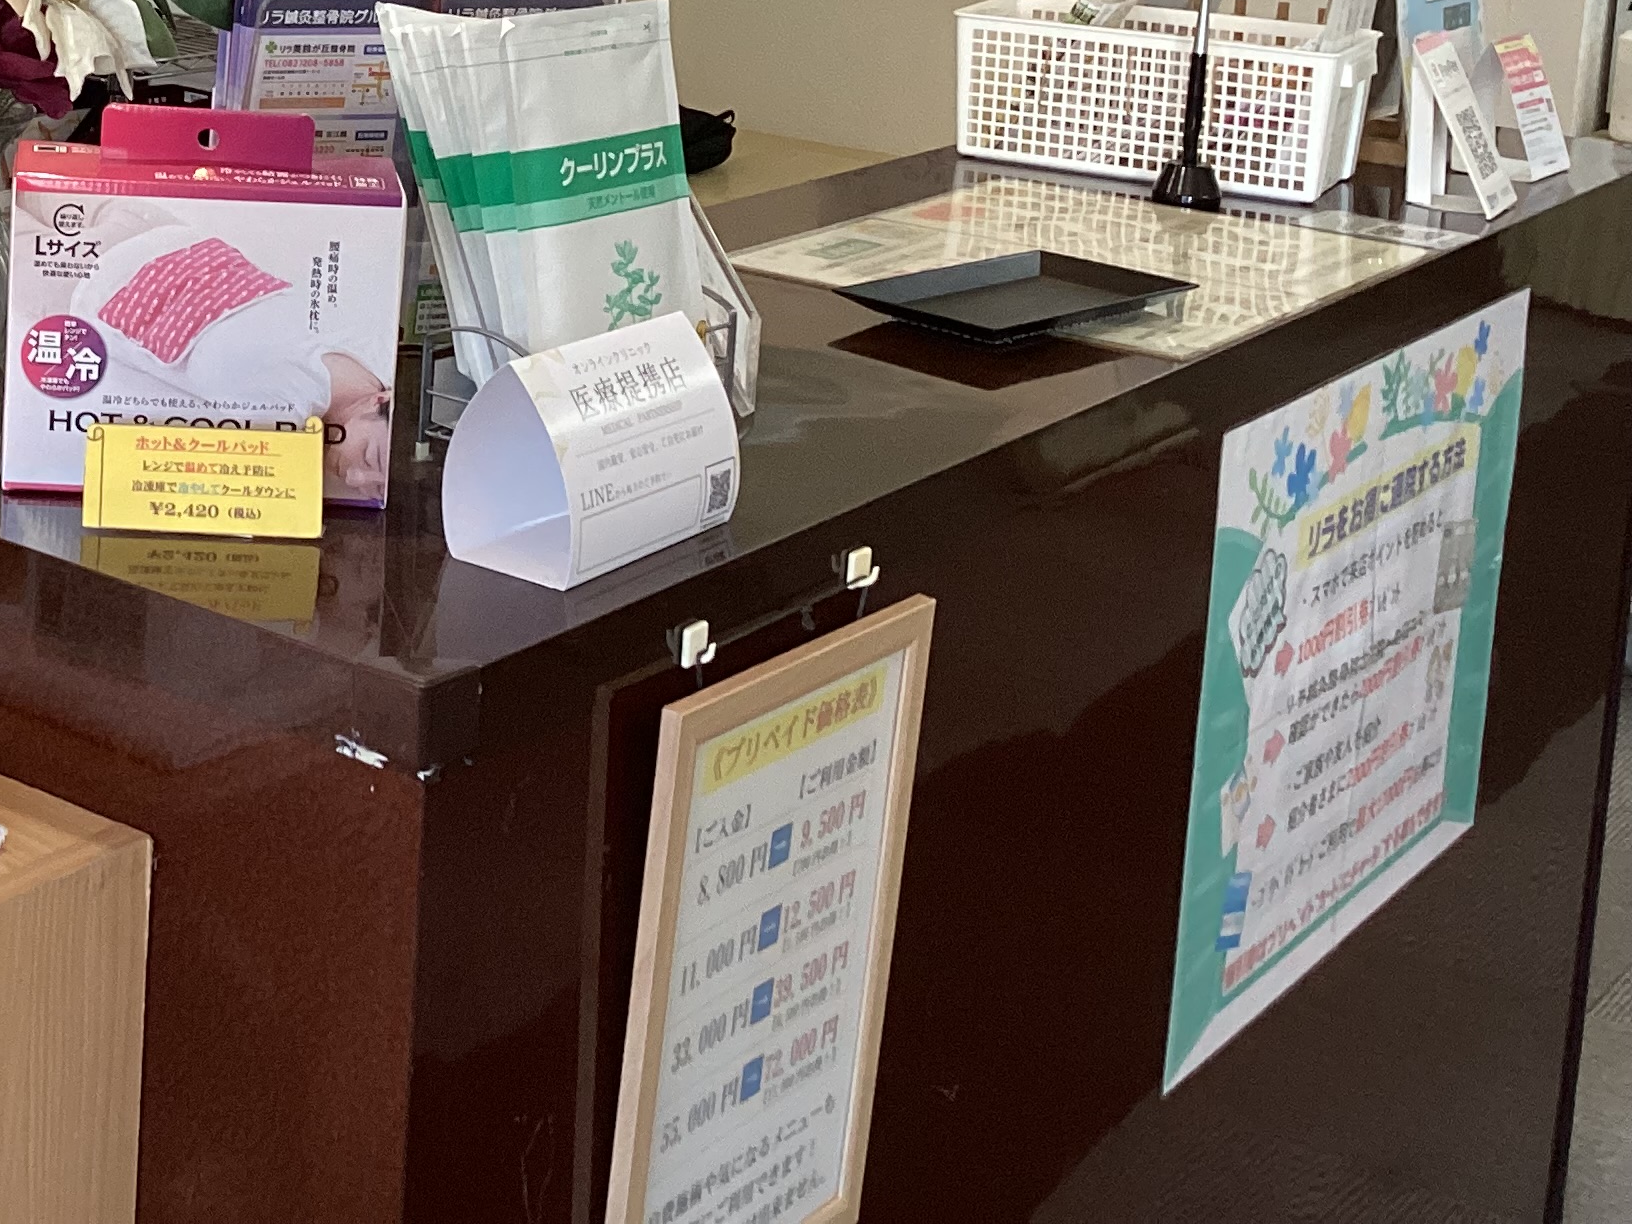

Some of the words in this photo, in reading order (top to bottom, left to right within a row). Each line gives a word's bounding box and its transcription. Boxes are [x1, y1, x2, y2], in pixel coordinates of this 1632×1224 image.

[560, 141, 667, 186] クーリンプラス
[36, 235, 101, 258] Lサイズ
[28, 329, 62, 364] 温
[572, 342, 651, 375] オンラインクリニック
[66, 347, 102, 382] 冷
[568, 356, 688, 422] 医療提携店
[275, 421, 347, 445] PD
[149, 501, 219, 518] ¥2,420
